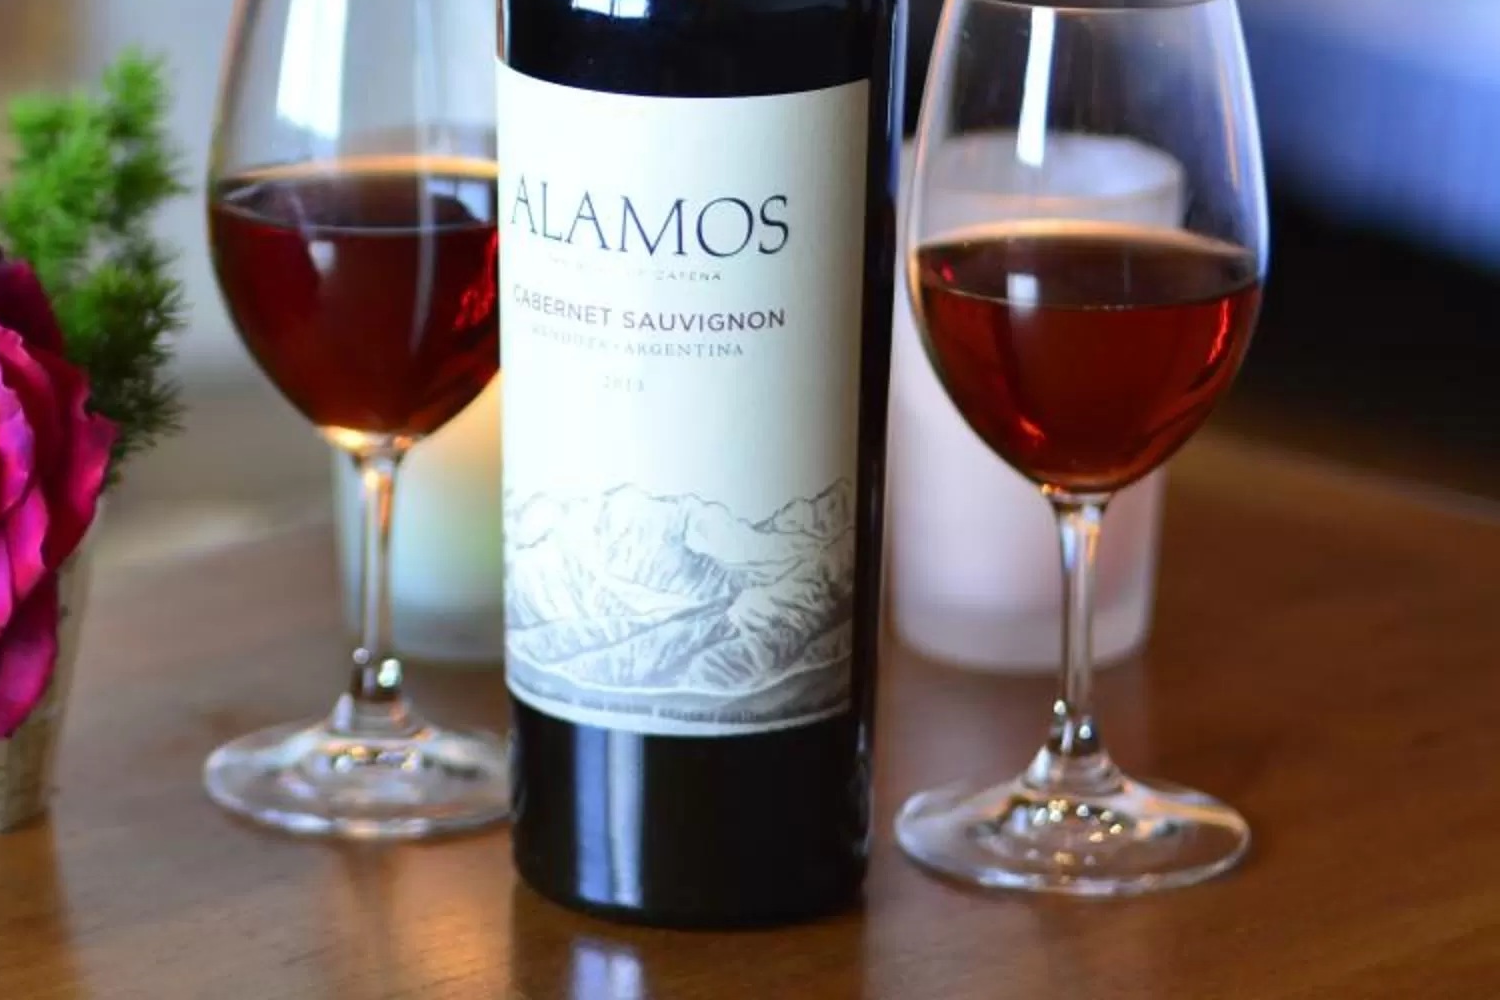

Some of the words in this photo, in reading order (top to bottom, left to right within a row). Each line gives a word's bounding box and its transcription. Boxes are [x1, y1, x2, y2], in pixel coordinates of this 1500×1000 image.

[511, 173, 790, 258] ALAMOS
[513, 283, 613, 327] CABERNET
[622, 307, 787, 333] SAUVIGNON
[624, 341, 745, 358] ARGENTINA
